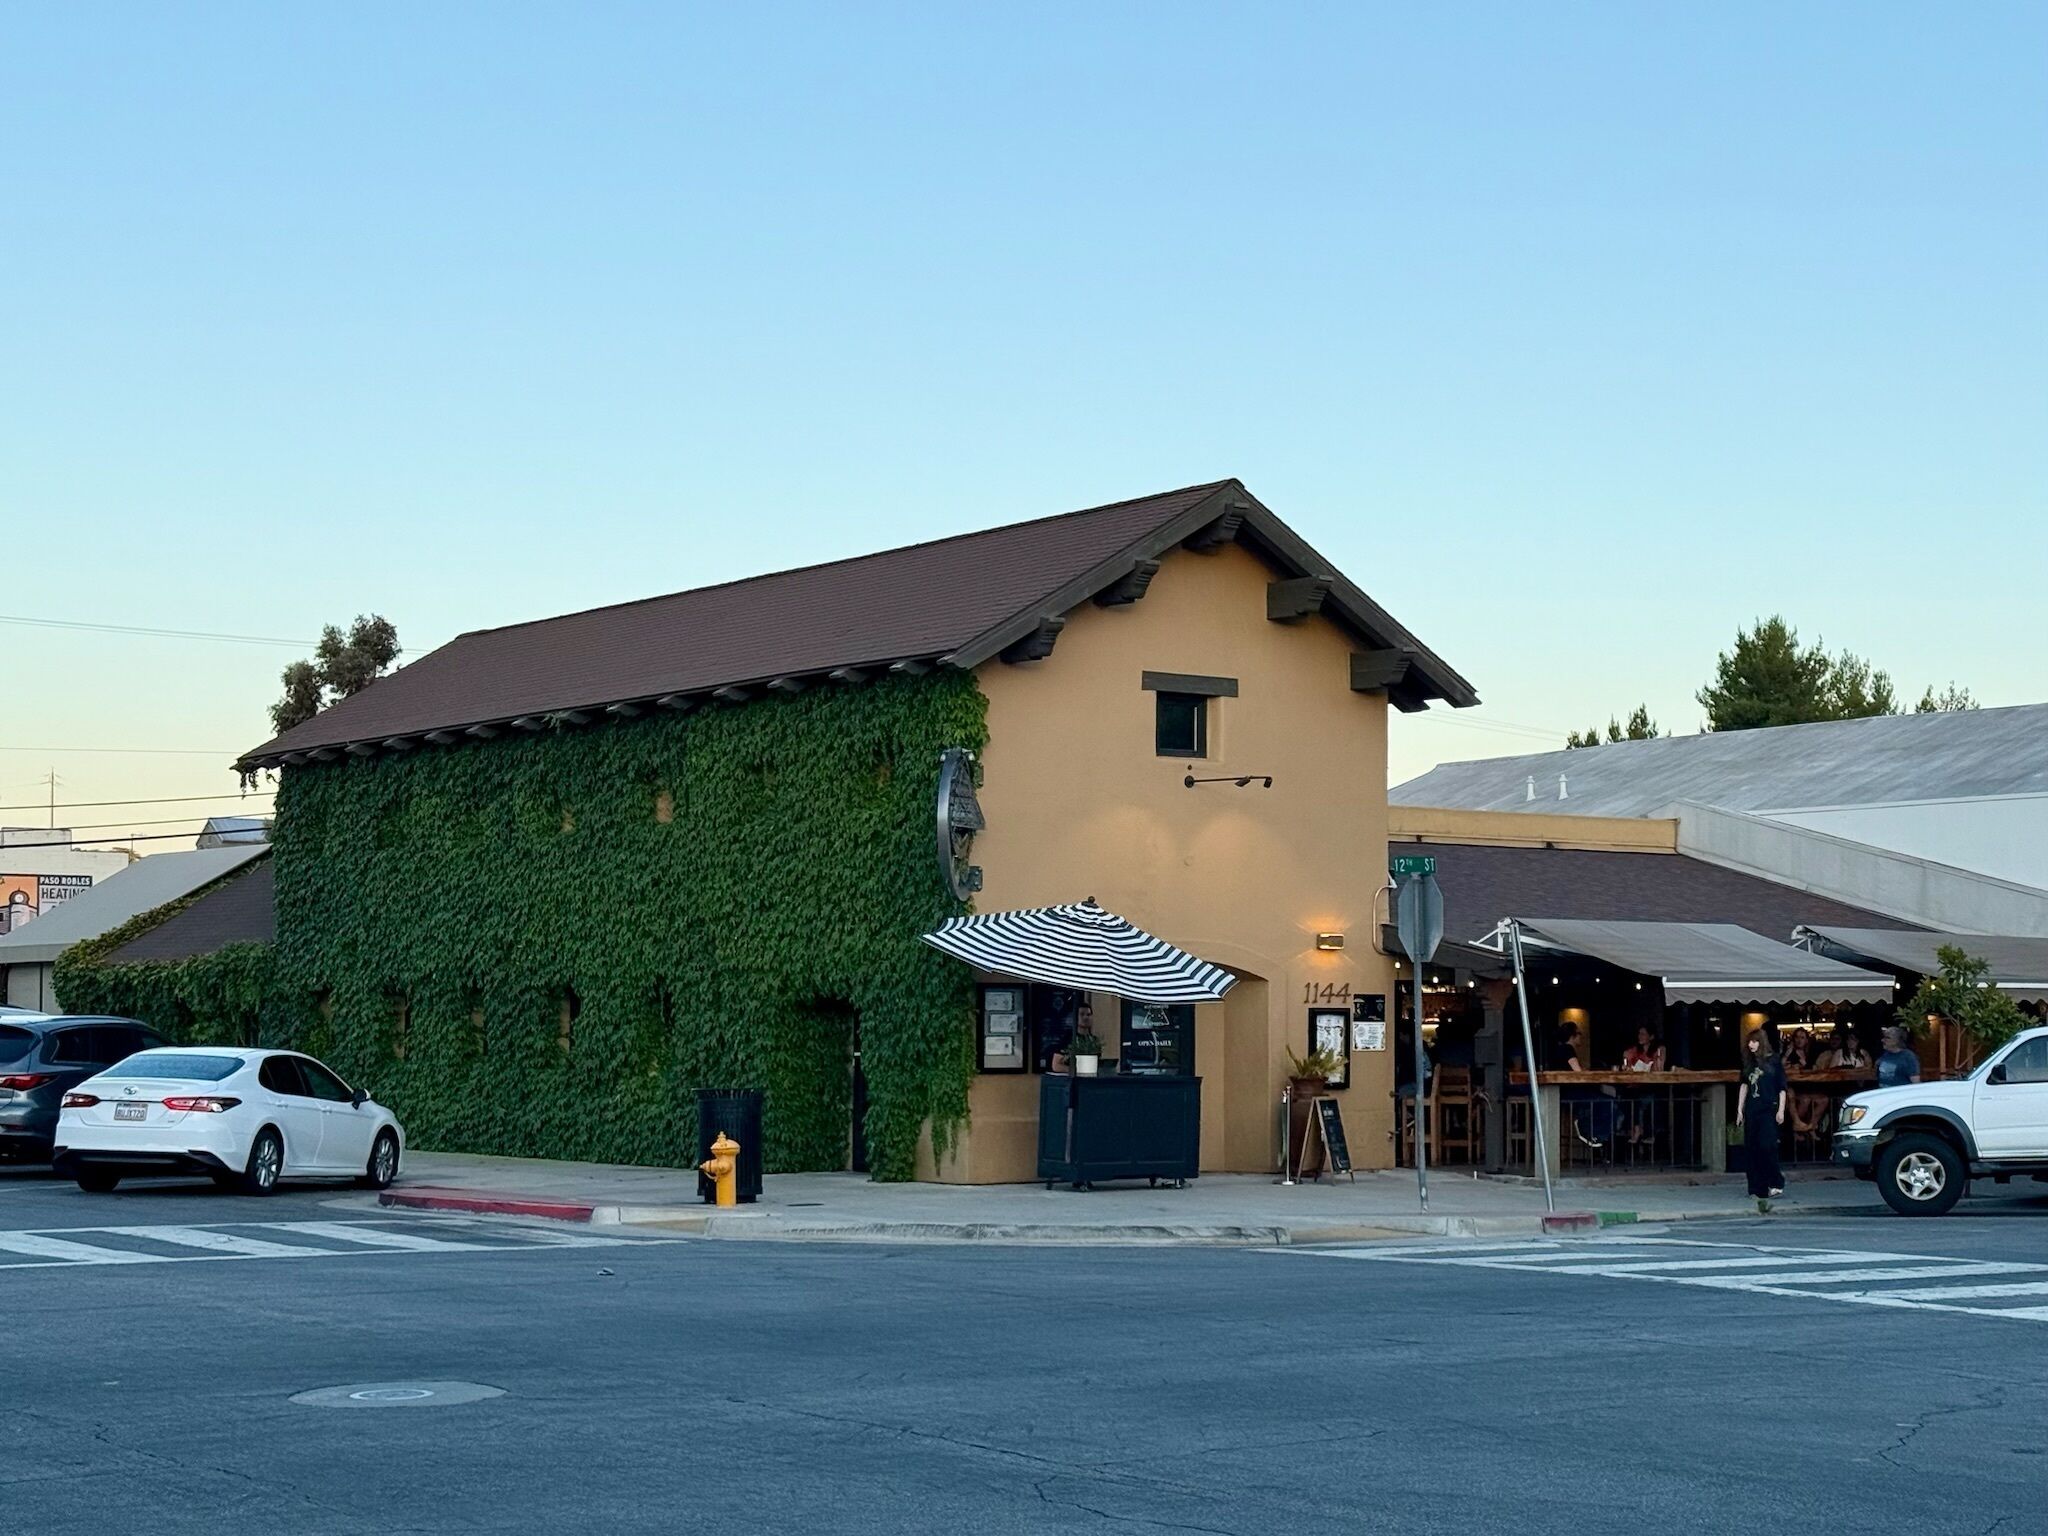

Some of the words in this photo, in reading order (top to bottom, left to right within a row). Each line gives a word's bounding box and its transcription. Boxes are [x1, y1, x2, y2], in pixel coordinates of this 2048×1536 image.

[1424, 857, 1435, 872] ST
[40, 876, 60, 885] PASO
[61, 877, 91, 885] ROBLES
[1303, 982, 1352, 1004] 1144
